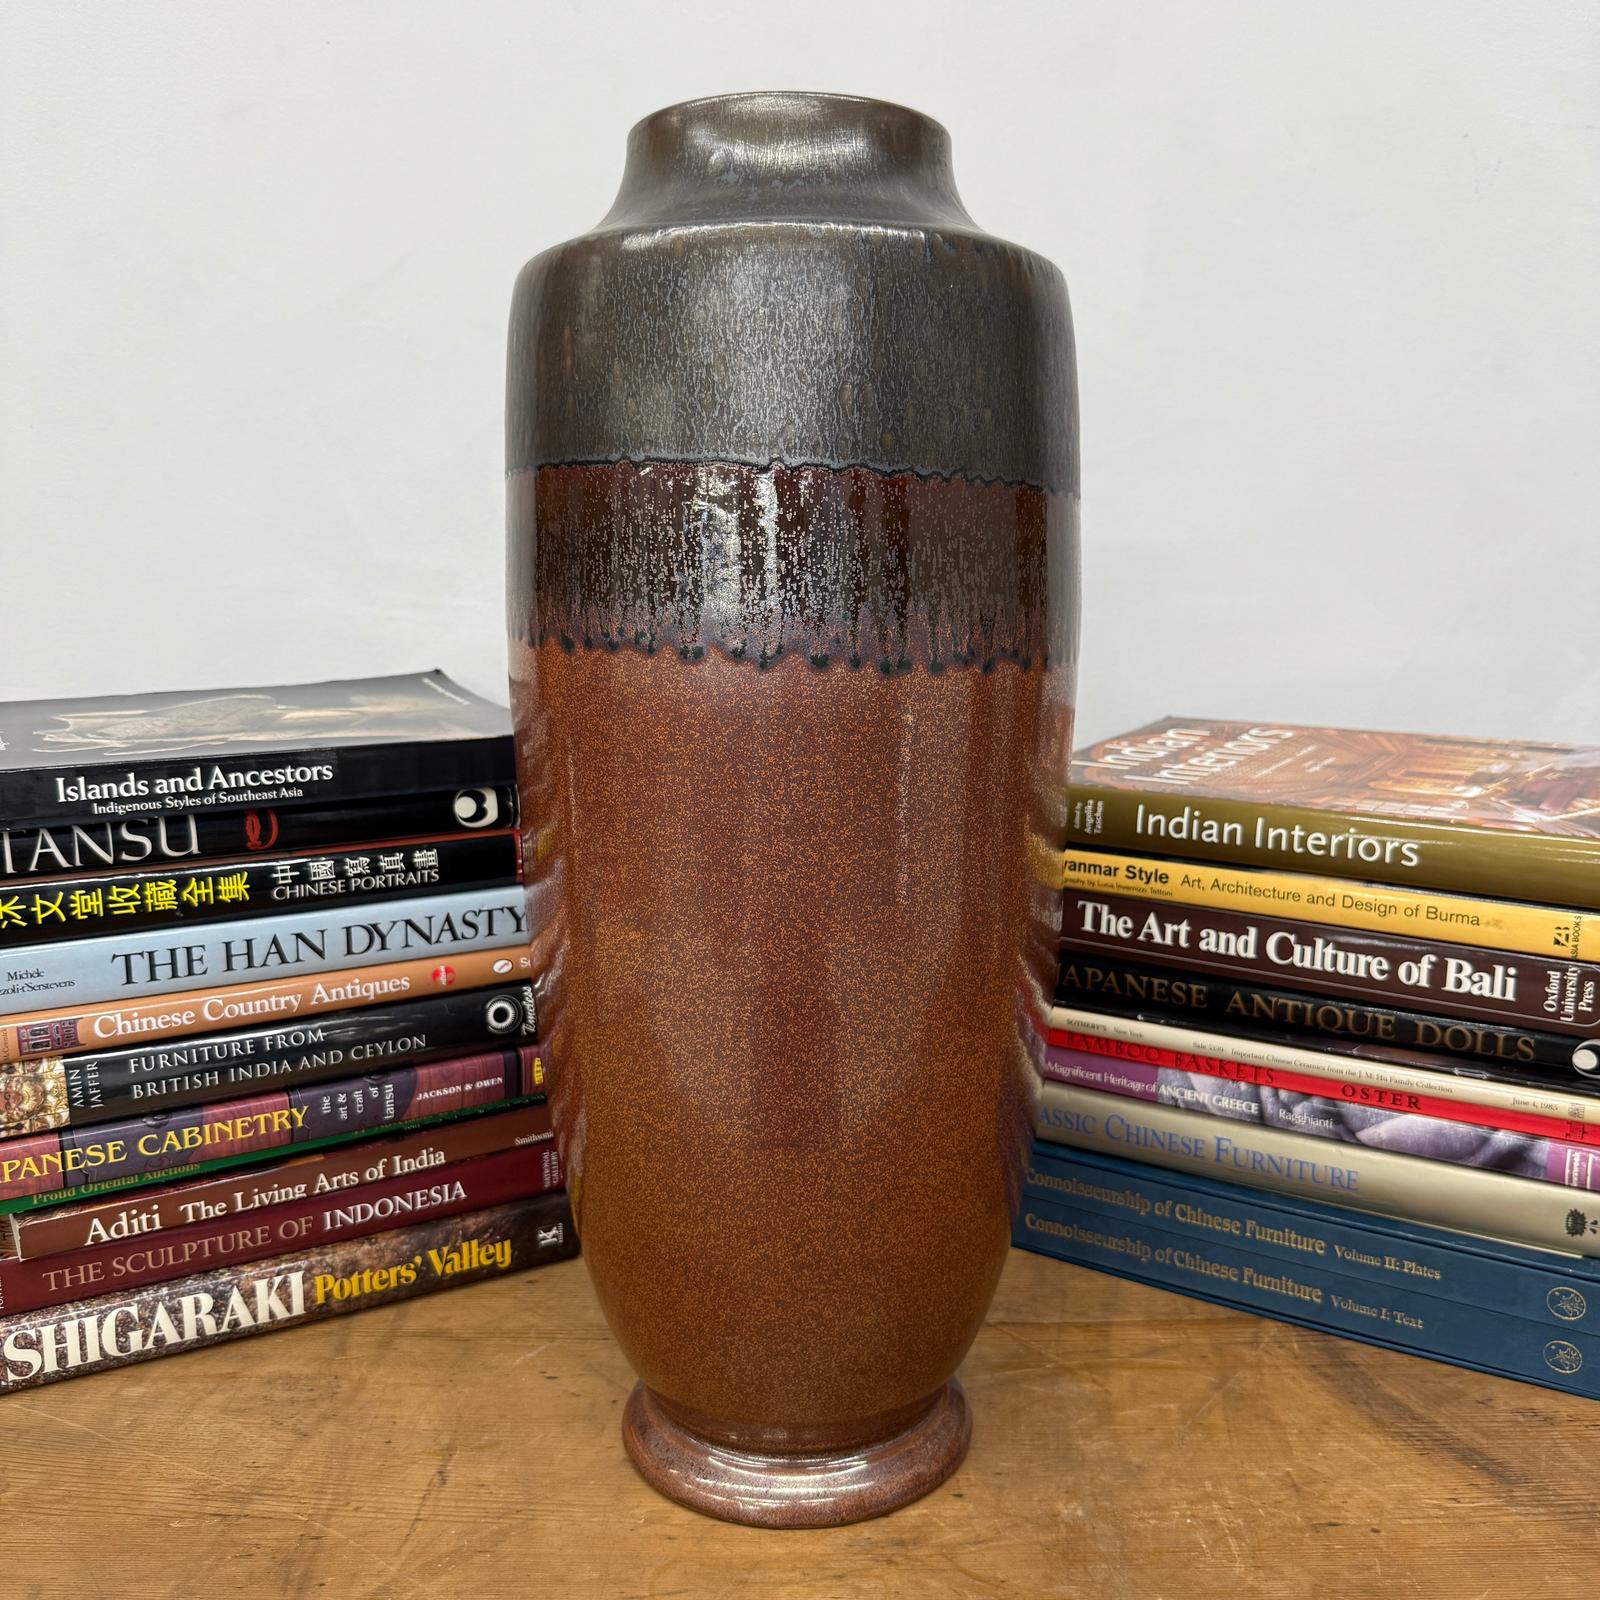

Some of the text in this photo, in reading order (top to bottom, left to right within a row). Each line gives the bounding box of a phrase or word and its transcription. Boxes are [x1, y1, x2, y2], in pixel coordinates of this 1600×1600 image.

[1071, 727, 1211, 770] Indian
[1123, 726, 1293, 785] Interiors
[56, 764, 333, 803] Islands and Ancestors
[93, 787, 303, 815] Indigenous Styles of Southeast Asia
[1136, 804, 1421, 868] Indian Interiors
[273, 869, 440, 900] CHINESE PORTRAITS
[1124, 864, 1170, 885] Style
[1180, 874, 1205, 891] Art,
[1210, 876, 1301, 902] Architecture
[1306, 892, 1336, 907] and
[1341, 894, 1398, 918] Design
[1403, 904, 1421, 919] of
[1425, 905, 1481, 927] Burma
[111, 906, 527, 986] THE HAN DYNASTY
[1077, 900, 1518, 1002] The Art and Culture of Bali
[1572, 915, 1582, 943] BOOKS
[94, 976, 410, 1038] Chinese Country Antiques
[1544, 970, 1561, 1013] Oxford
[1560, 964, 1582, 1022] University
[1578, 980, 1595, 1013] Press
[1114, 1026, 1127, 1035] New
[1128, 1028, 1144, 1039] York
[1225, 991, 1396, 1040] ANTIQUE
[1414, 1018, 1537, 1062] DOLLS
[129, 1028, 325, 1074] FURNITURE FROM
[132, 1033, 427, 1100] BRITISH INDIA AND CEYLON
[1066, 1031, 1422, 1110] BAMBOO BASKETS OSTER
[69, 1069, 85, 1108] AMIN
[86, 1061, 104, 1109] JAFFER
[353, 1089, 364, 1113] craft
[369, 1086, 379, 1098] of
[416, 1077, 503, 1100] JACKSON & OWEN
[1047, 1061, 1334, 1130] Magnificent Heritage of ANCIENT GREECE Ragghianti
[1231, 1047, 1265, 1061] Important
[1266, 1054, 1292, 1066] Chinese
[1294, 1058, 1326, 1071] Ceramics
[1327, 1065, 1344, 1075] from
[1345, 1068, 1357, 1077] the
[1389, 1074, 1414, 1088] Family
[1415, 1079, 1453, 1094] Collection
[1512, 1097, 1529, 1107] June
[322, 1095, 332, 1114] the
[338, 1093, 348, 1120] art &
[384, 1084, 395, 1120] tansu
[138, 1106, 309, 1156] CABINETRY
[0, 1140, 128, 1184] PANESE
[32, 1161, 200, 1205] Proud Oriental Auctions
[84, 1147, 446, 1246] Aditi The Living Arts of India
[42, 1180, 467, 1292] THE SCULPTURE OF INDONESIA
[1025, 1167, 1442, 1281] Connoisseurship of Chinese Furniture Volume II: Plates
[1024, 1212, 1425, 1329] Connoisseurship of Chinese Furniture Volume I: Text
[4, 1270, 307, 1381] SHIGARAKI
[314, 1256, 422, 1306] Potters'
[428, 1239, 512, 1277] Valley
